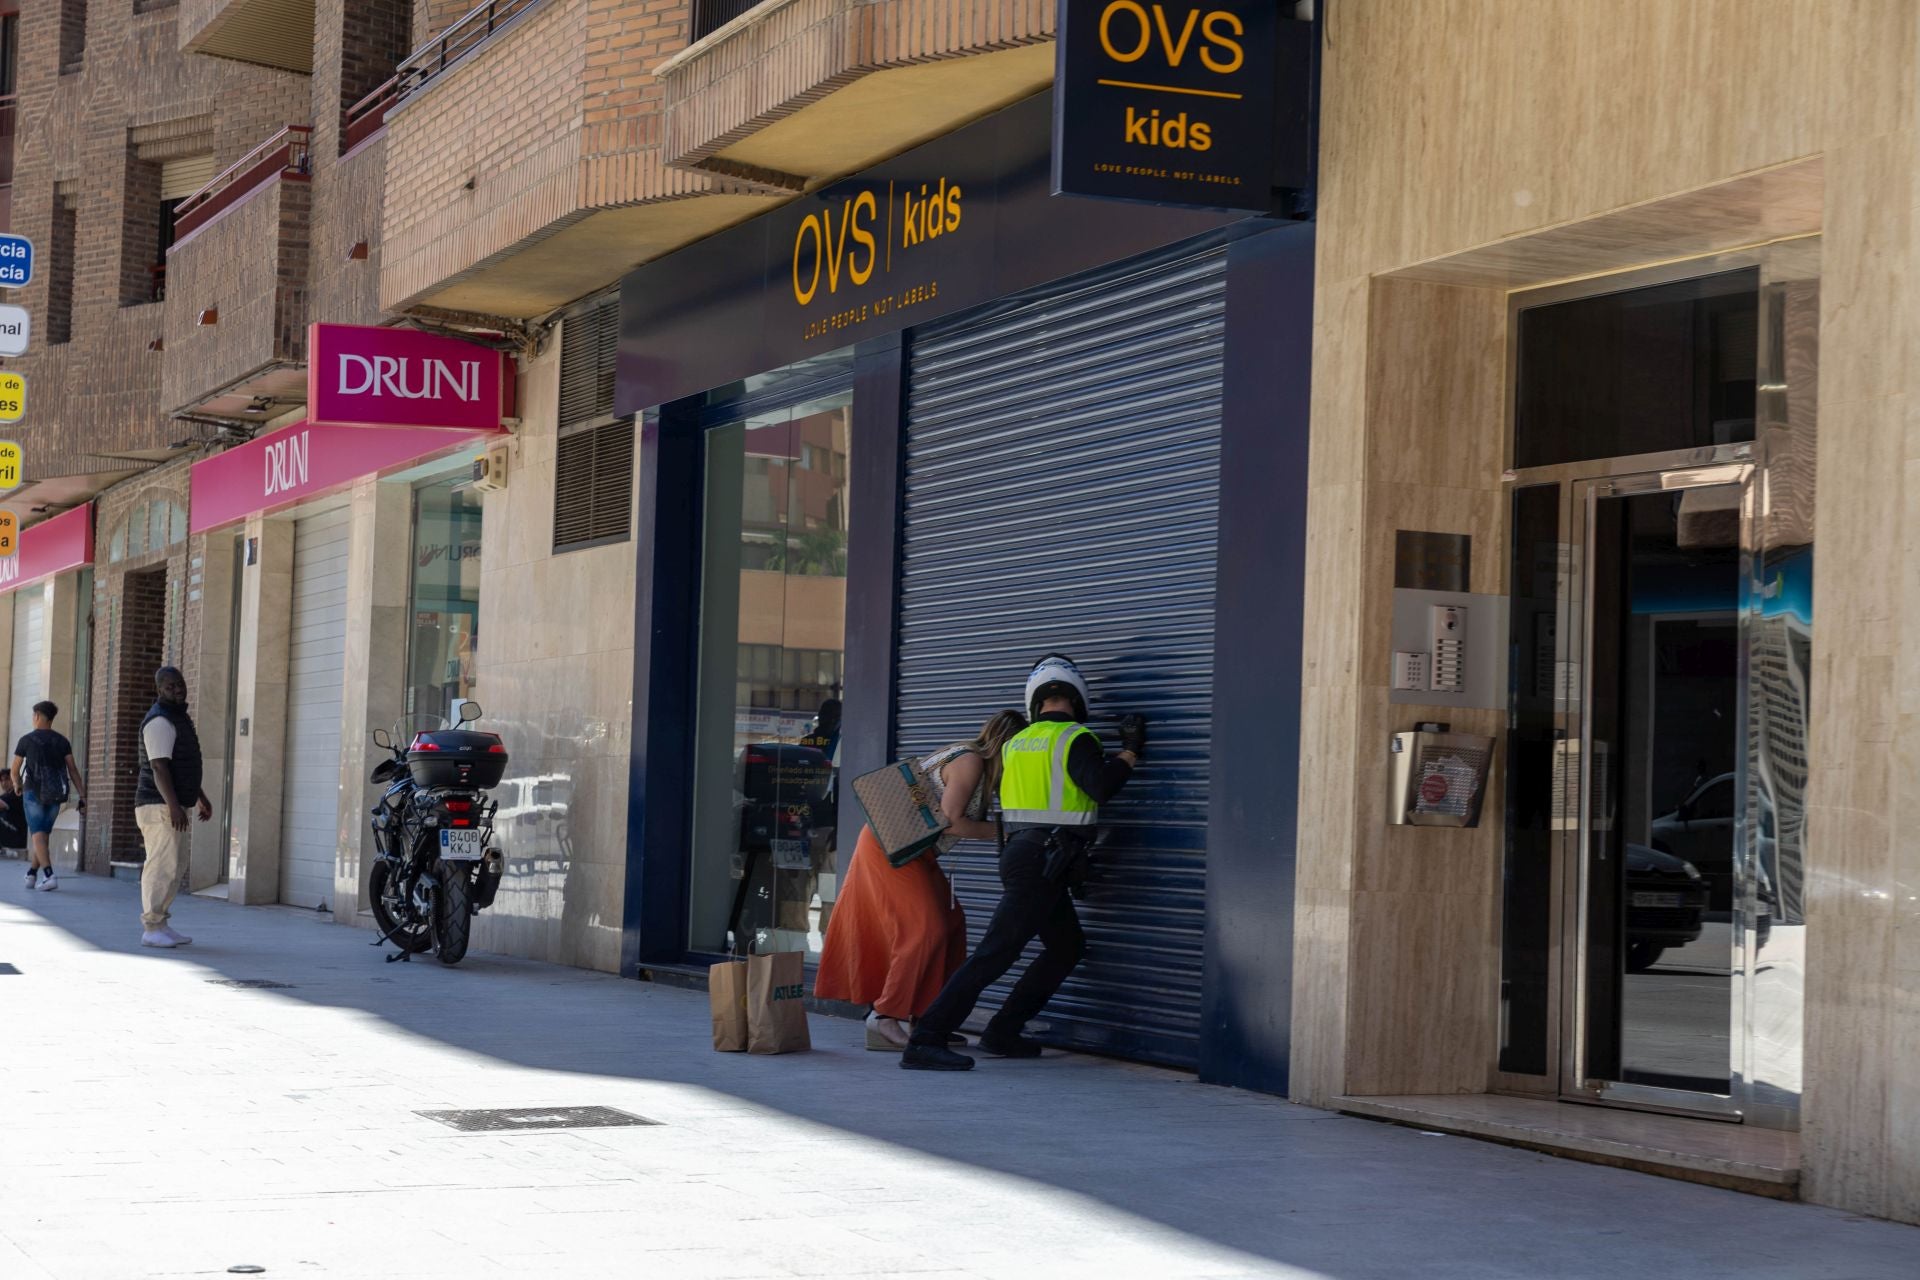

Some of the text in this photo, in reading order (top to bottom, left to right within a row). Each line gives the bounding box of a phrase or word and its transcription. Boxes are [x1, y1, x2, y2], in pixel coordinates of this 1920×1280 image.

[1099, 0, 1244, 74] OVS
[1125, 107, 1212, 152] kids
[1094, 163, 1121, 174] LOVE
[1173, 171, 1195, 180] NOT
[0, 243, 26, 258] cia
[793, 177, 961, 306] OVS kids
[804, 318, 828, 340] LOVE
[873, 296, 894, 317] NOT
[5, 379, 19, 390] de
[337, 353, 481, 402] DRUNI
[264, 430, 310, 497] DRUNI
[787, 804, 810, 816] OVS
[450, 843, 472, 854] KKJ
